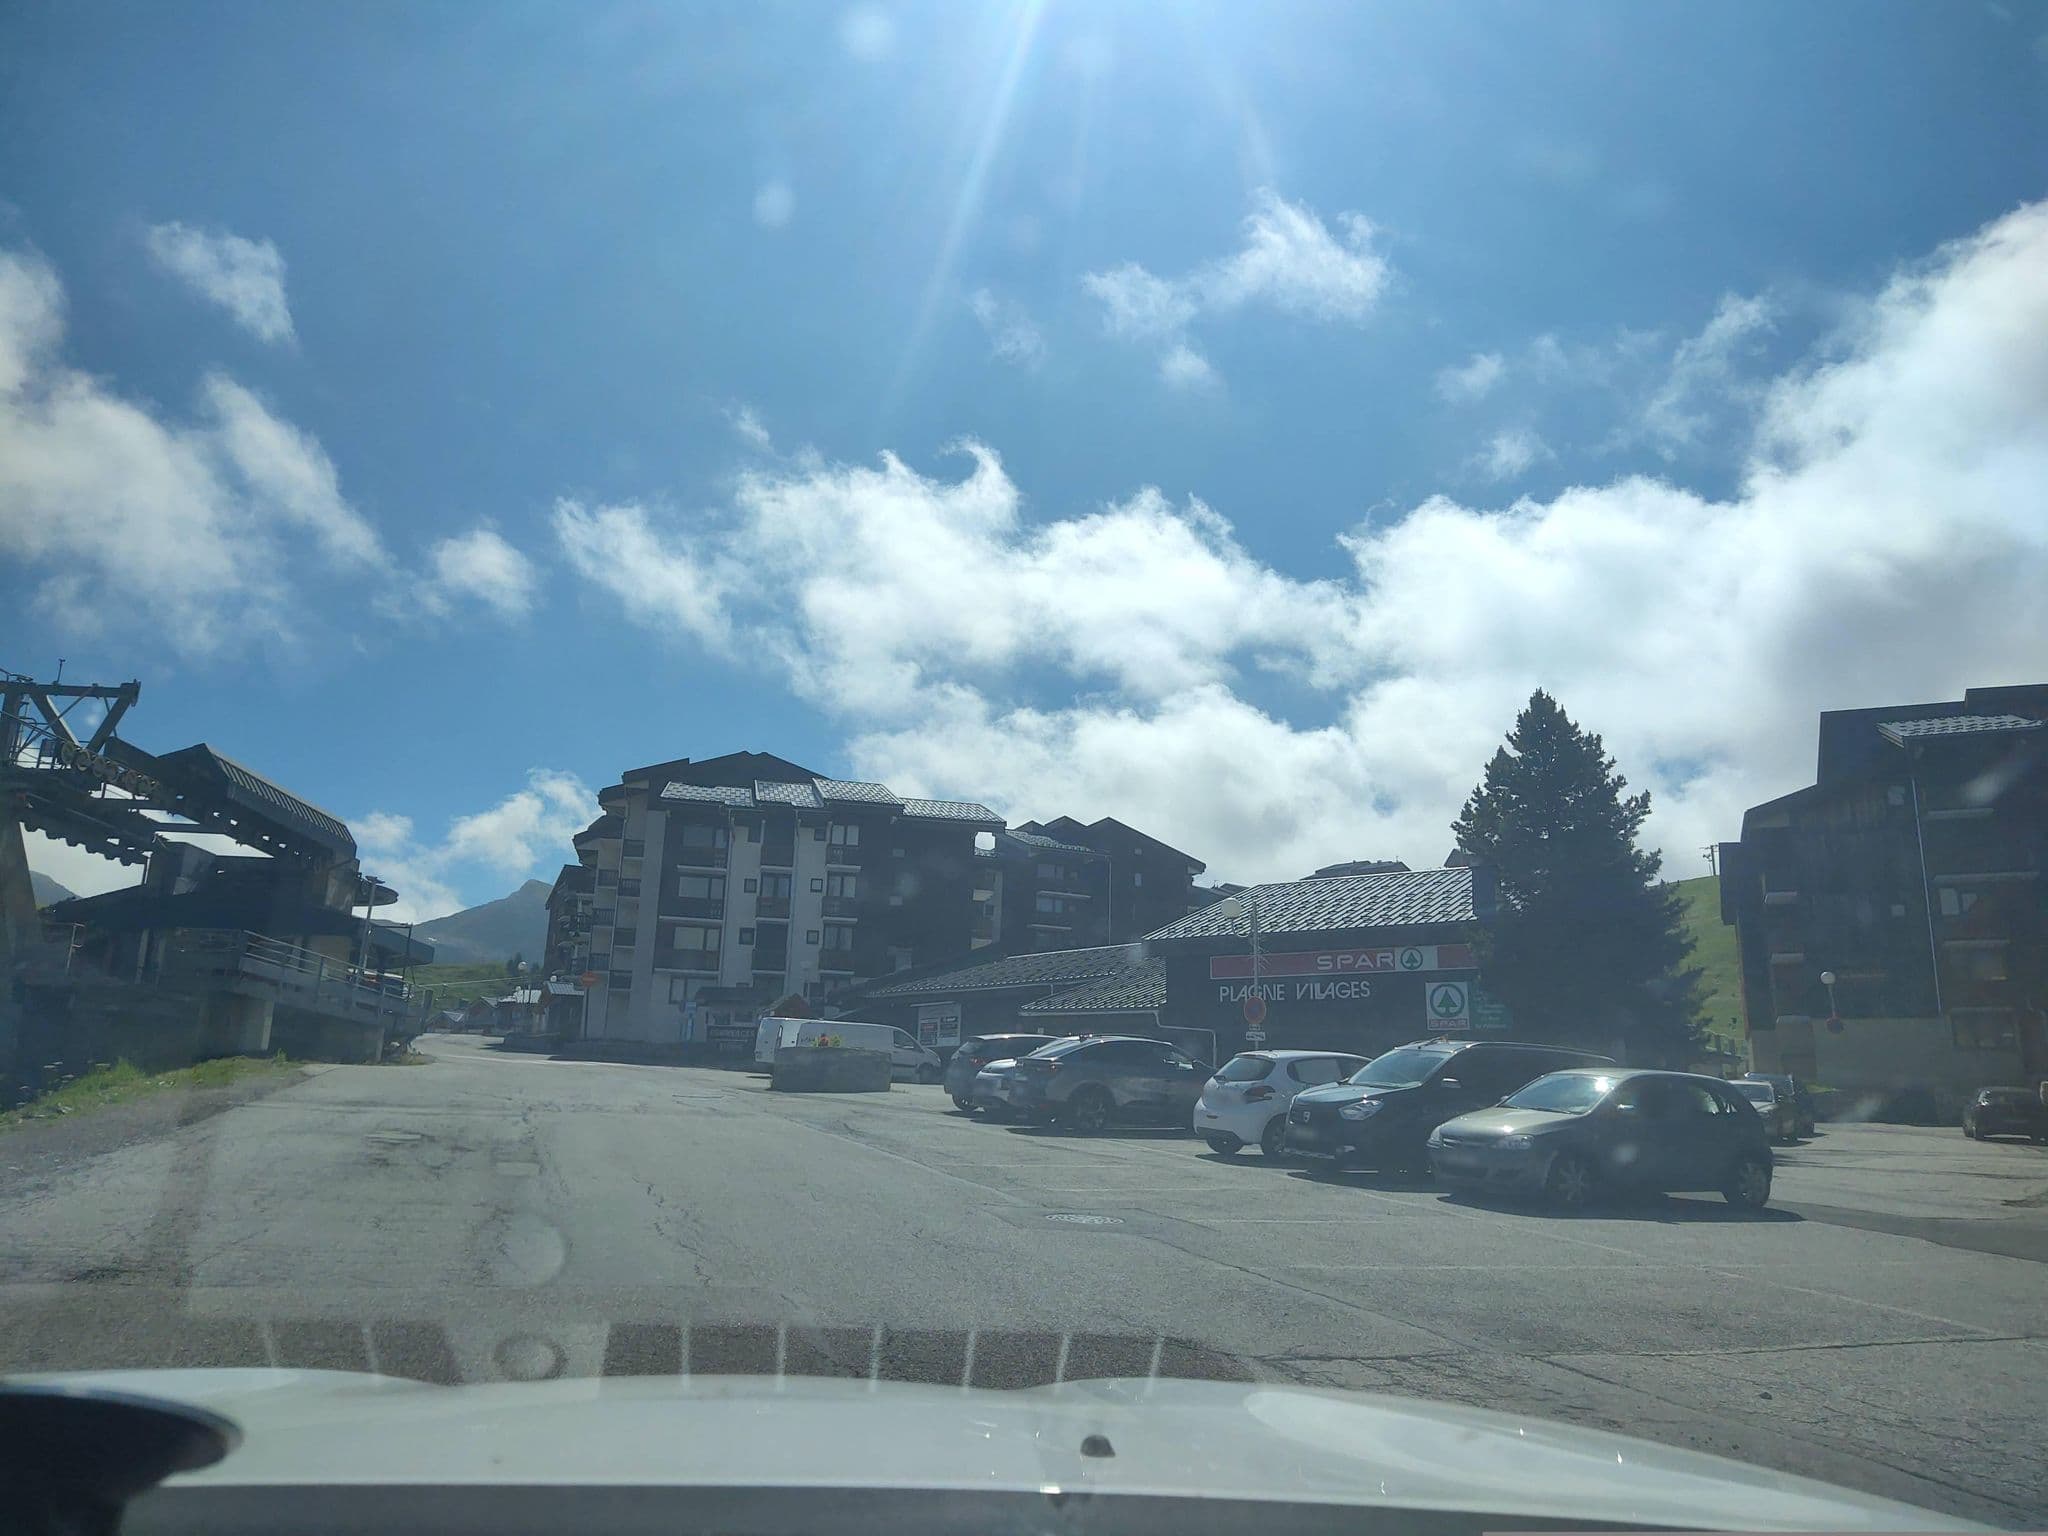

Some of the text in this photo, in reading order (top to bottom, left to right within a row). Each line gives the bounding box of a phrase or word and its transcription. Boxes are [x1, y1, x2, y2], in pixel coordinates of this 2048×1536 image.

[1316, 951, 1395, 971] SPAR
[1219, 980, 1371, 1002] PLAGNE VILLAGES
[1429, 1018, 1467, 1028] SPAR
